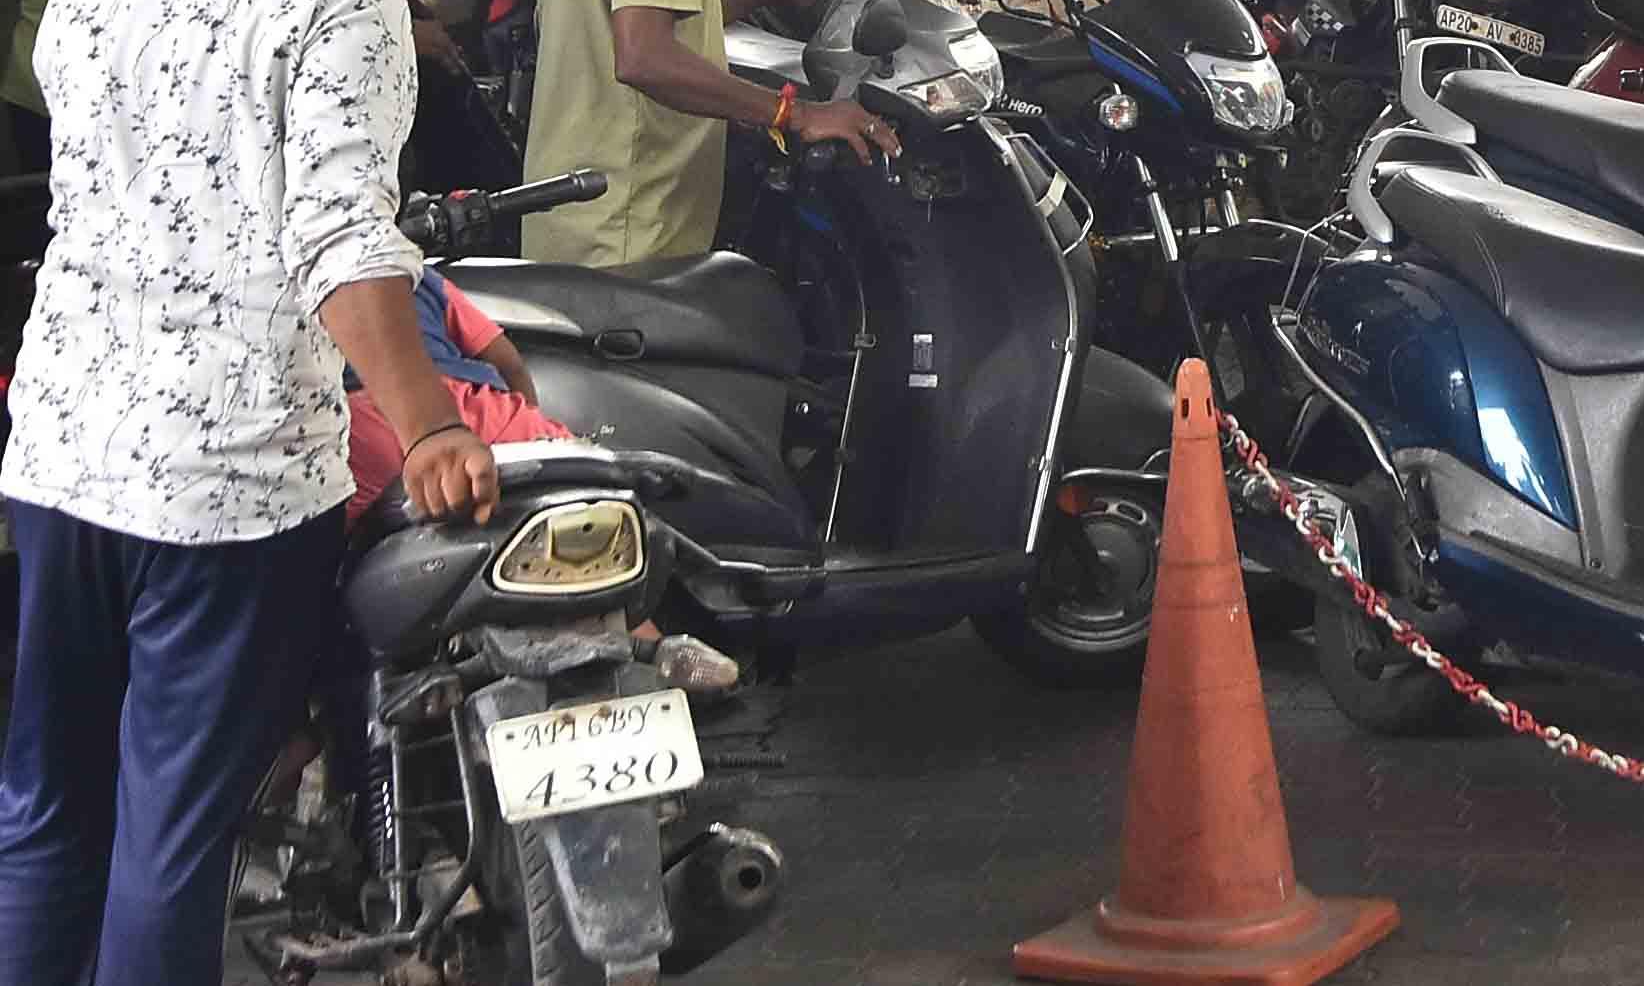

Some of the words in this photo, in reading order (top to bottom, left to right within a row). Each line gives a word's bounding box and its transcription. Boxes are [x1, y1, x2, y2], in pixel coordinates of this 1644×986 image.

[1440, 9, 1473, 34] AP20
[1486, 21, 1504, 42] AV
[1512, 29, 1543, 55] 0385
[524, 750, 679, 808] 4380
